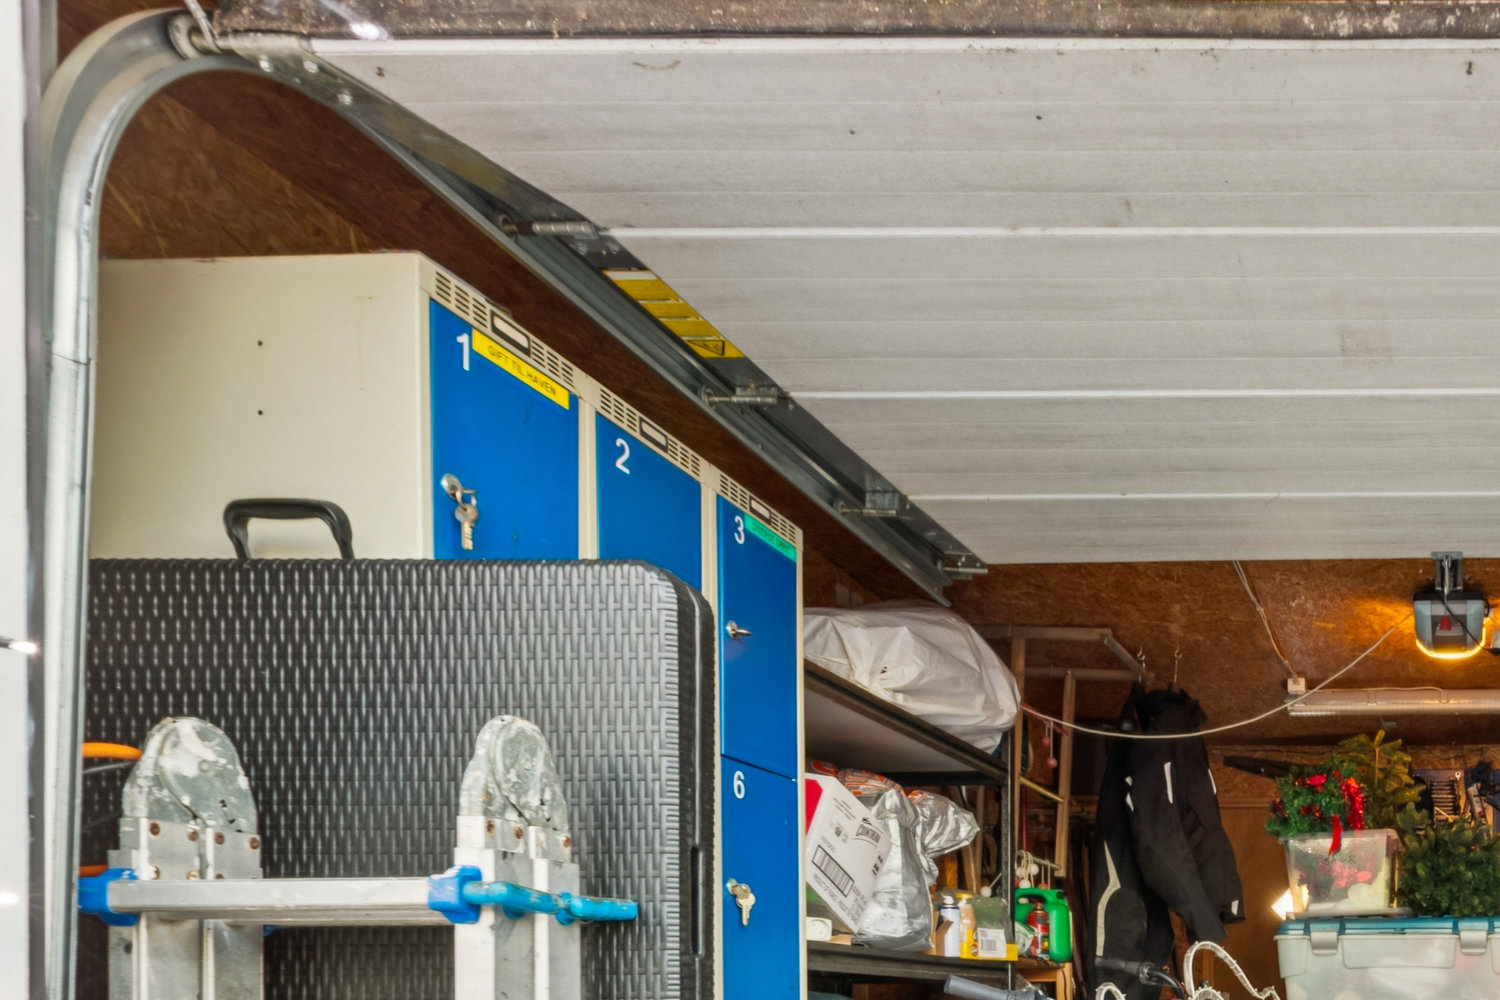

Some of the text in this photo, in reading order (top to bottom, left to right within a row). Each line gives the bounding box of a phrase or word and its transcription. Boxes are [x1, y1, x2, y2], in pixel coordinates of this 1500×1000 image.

[456, 333, 470, 371] 1
[488, 345, 557, 396] GIFT TIL HAVEN
[615, 438, 630, 474] 2
[734, 515, 745, 544] 3
[733, 770, 746, 799] 6
